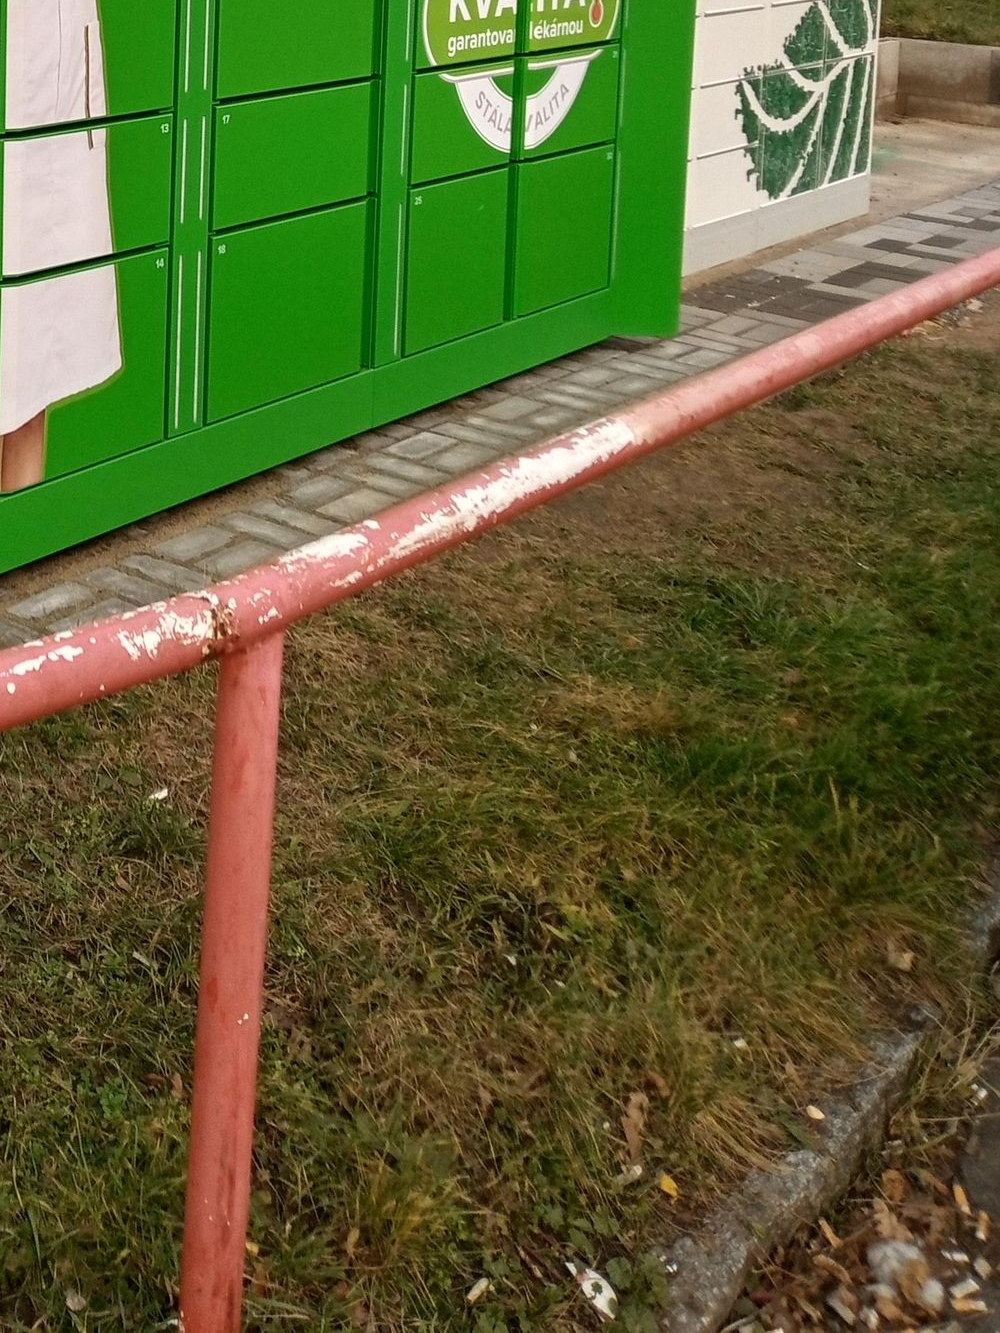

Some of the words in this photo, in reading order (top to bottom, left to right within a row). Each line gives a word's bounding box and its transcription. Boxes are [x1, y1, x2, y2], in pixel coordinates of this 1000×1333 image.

[447, 28, 516, 57] garantova
[529, 18, 584, 40] lékárnou
[222, 114, 232, 126] 17
[160, 122, 170, 134] 13
[414, 194, 424, 206] 25
[217, 243, 227, 255] 18
[155, 257, 166, 269] 14
